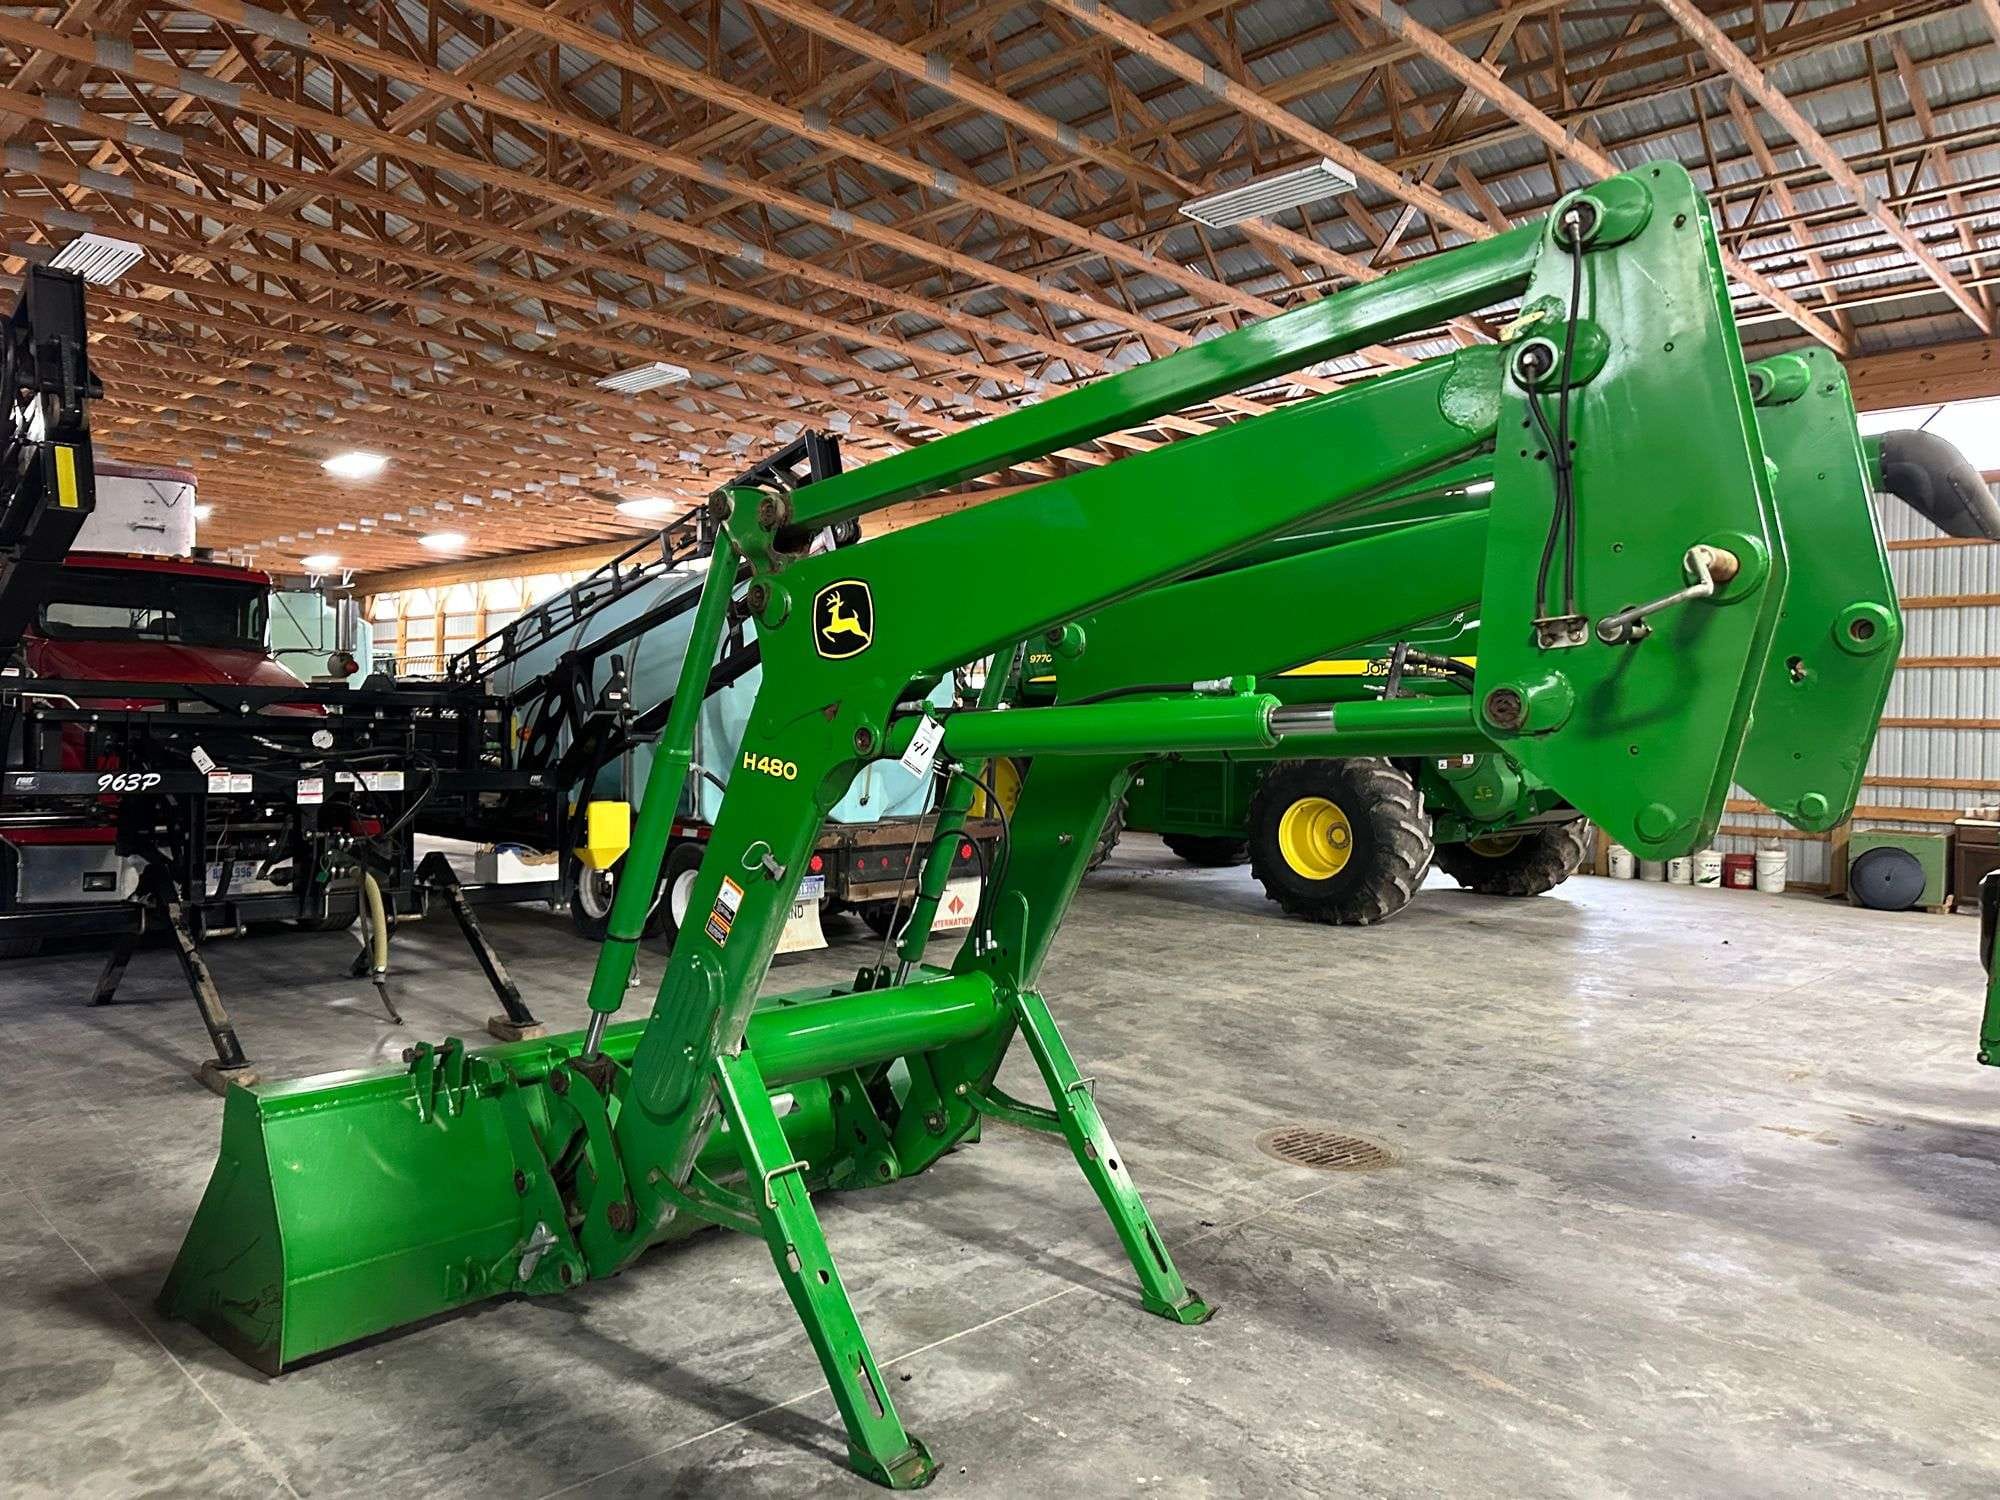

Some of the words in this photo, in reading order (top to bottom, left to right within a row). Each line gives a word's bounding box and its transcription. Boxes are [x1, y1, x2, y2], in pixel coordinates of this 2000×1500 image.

[913, 741, 929, 756] 41
[742, 751, 798, 781] H480
[97, 773, 161, 792] 963P
